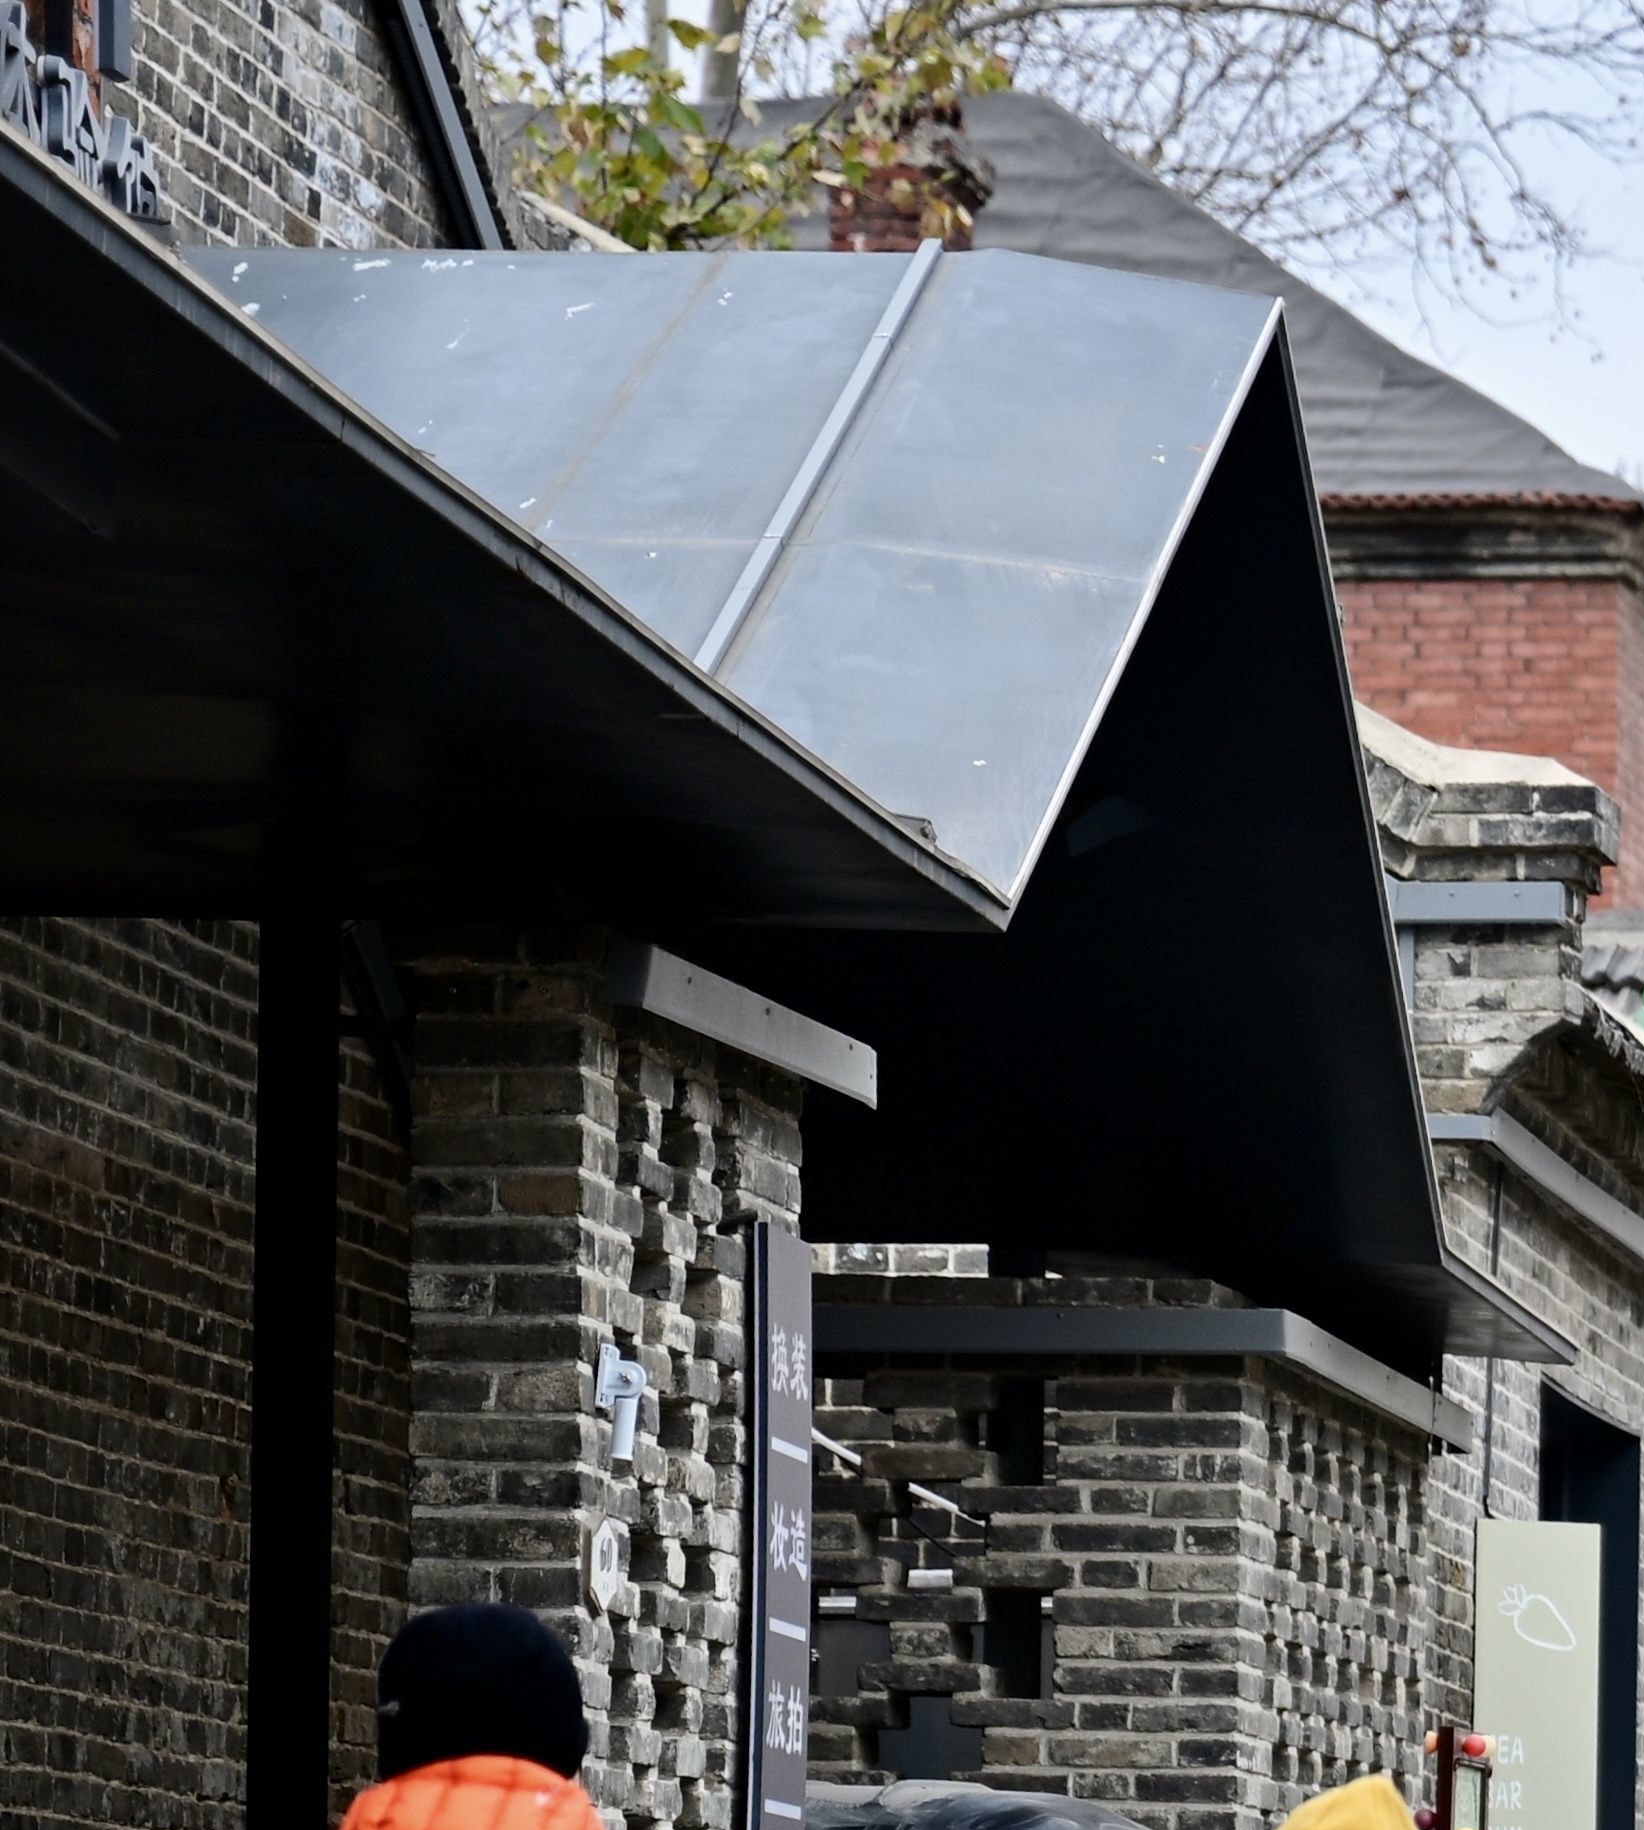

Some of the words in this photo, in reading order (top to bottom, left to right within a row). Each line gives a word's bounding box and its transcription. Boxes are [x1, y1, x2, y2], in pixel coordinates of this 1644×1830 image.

[771, 1322, 809, 1401] 换装
[770, 1501, 808, 1581] 妆造
[766, 1679, 804, 1756] 旅拍
[1494, 1735, 1524, 1764] EA
